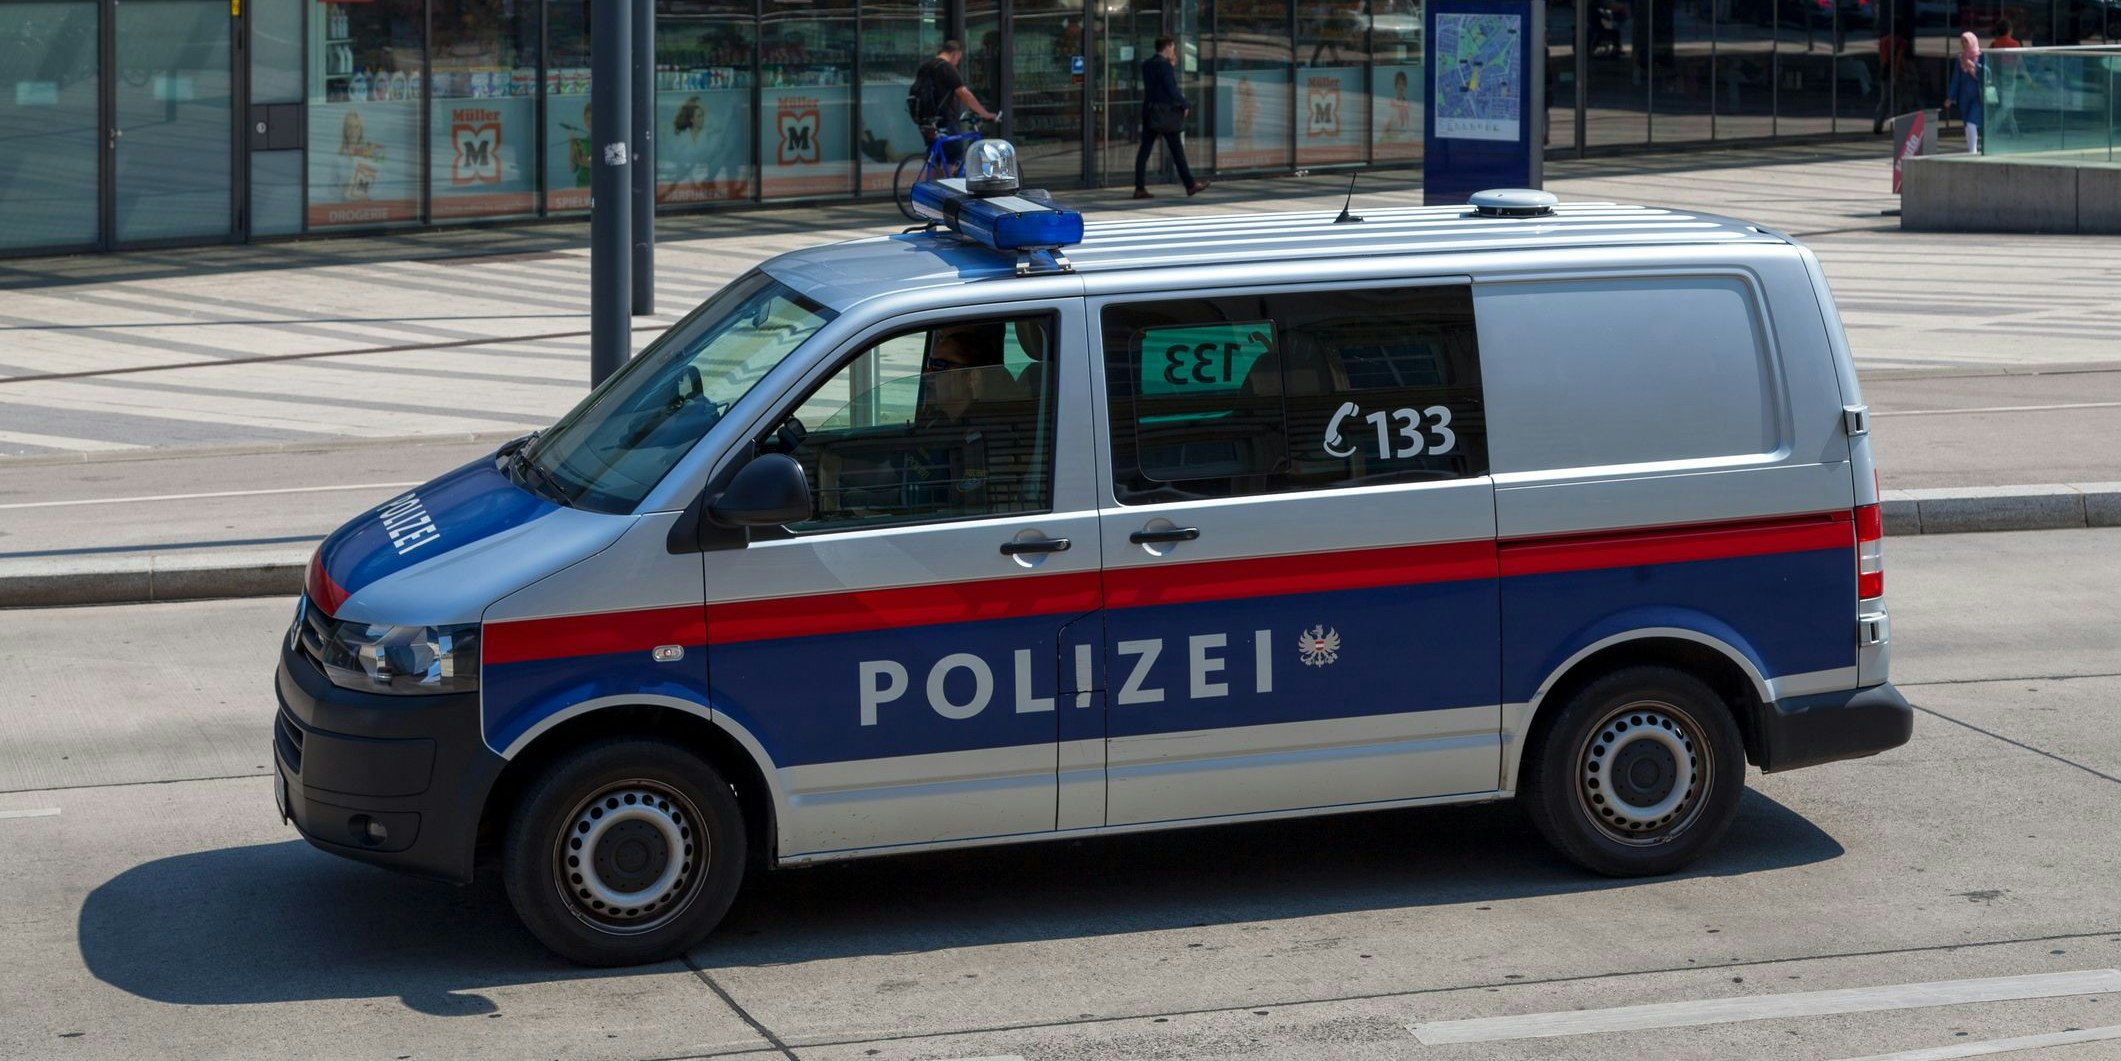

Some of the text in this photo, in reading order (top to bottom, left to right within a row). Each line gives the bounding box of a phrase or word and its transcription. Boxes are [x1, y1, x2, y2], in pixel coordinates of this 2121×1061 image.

[453, 107, 501, 122] Müller
[1315, 103, 1332, 124] M
[788, 126, 810, 150] M
[464, 140, 489, 167] M
[329, 207, 389, 223] DROGERIE
[1366, 405, 1456, 460] 133
[377, 493, 440, 555] POLIZEI
[859, 629, 1273, 727] POLIZEI
